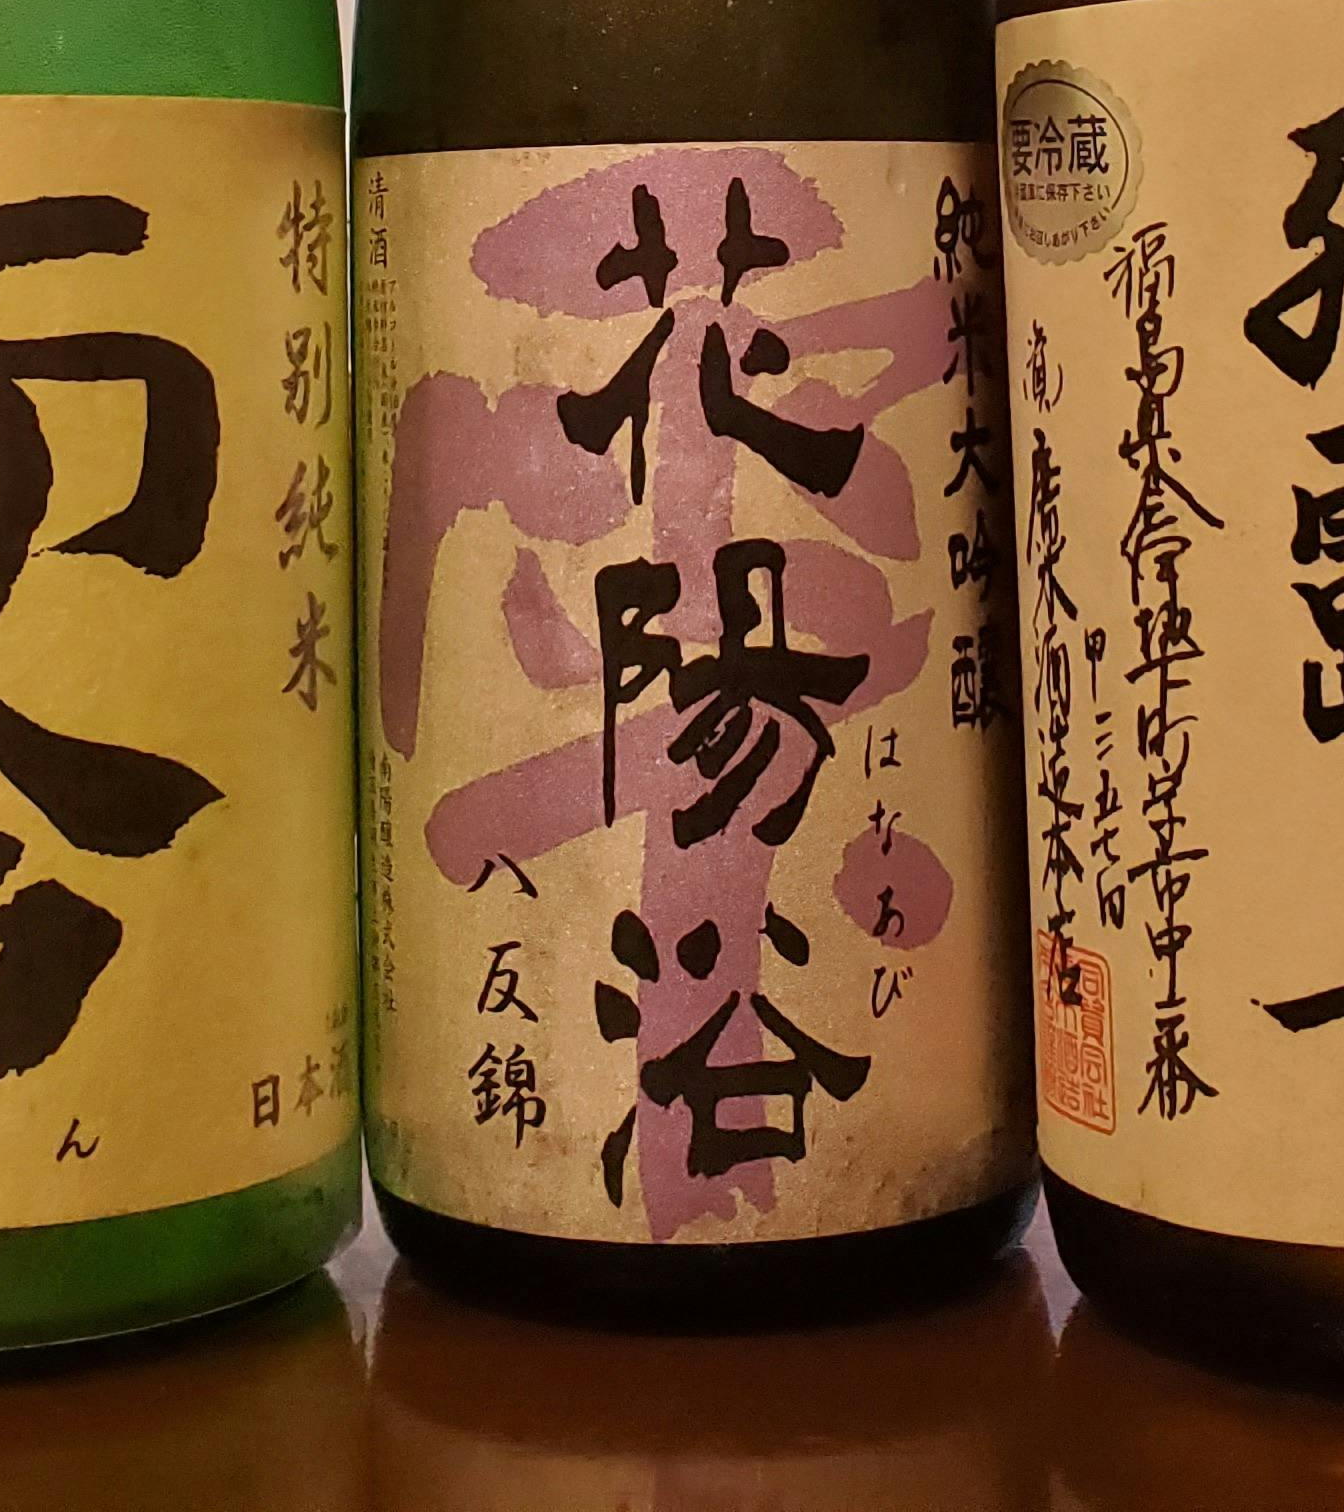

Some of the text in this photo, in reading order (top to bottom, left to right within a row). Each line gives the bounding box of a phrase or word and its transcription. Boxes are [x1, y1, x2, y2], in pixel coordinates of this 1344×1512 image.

[1009, 114, 1110, 176] 要冷蔵
[275, 179, 340, 713] 特別純米
[557, 176, 872, 1209] 花陽浴
[466, 853, 547, 1150] 八反錦
[863, 724, 916, 1019] はなあび
